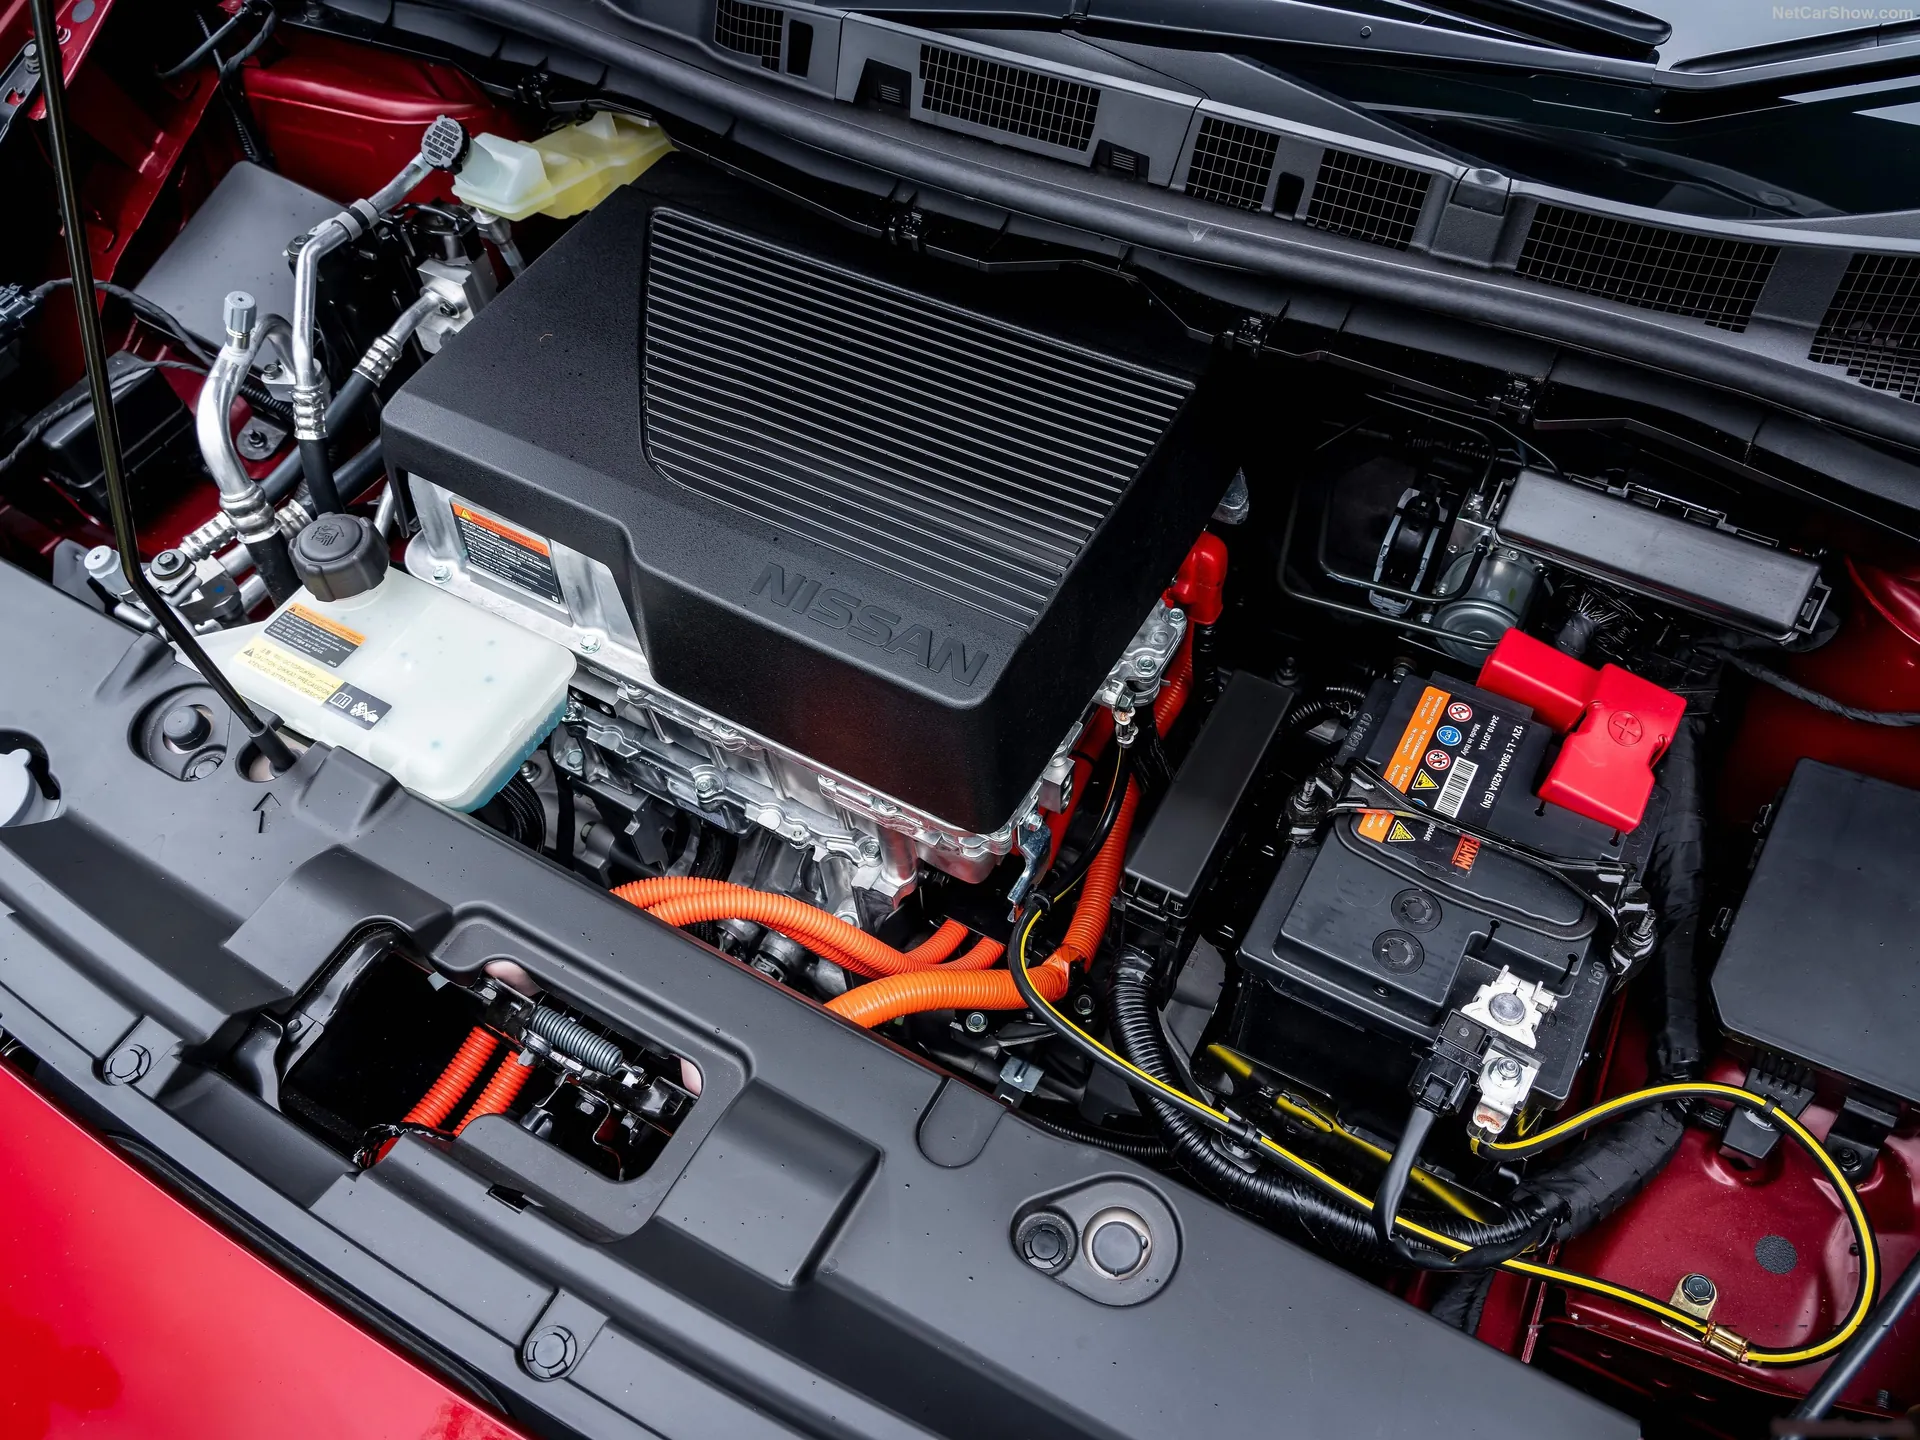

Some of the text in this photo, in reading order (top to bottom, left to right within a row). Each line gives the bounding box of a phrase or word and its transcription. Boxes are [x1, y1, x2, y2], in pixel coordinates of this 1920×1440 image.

[750, 562, 989, 686] NISSAN
[1486, 714, 1499, 733] 24410
[1510, 723, 1523, 740] 12V
[1459, 722, 1481, 756] Made in Italy
[1504, 742, 1515, 753] L1
[1496, 752, 1511, 773] 50Ah
[1487, 771, 1503, 792] 420A
[1479, 789, 1495, 809] (EN)
[1455, 838, 1480, 871] IAMM
[1587, 961, 1606, 986] 160
